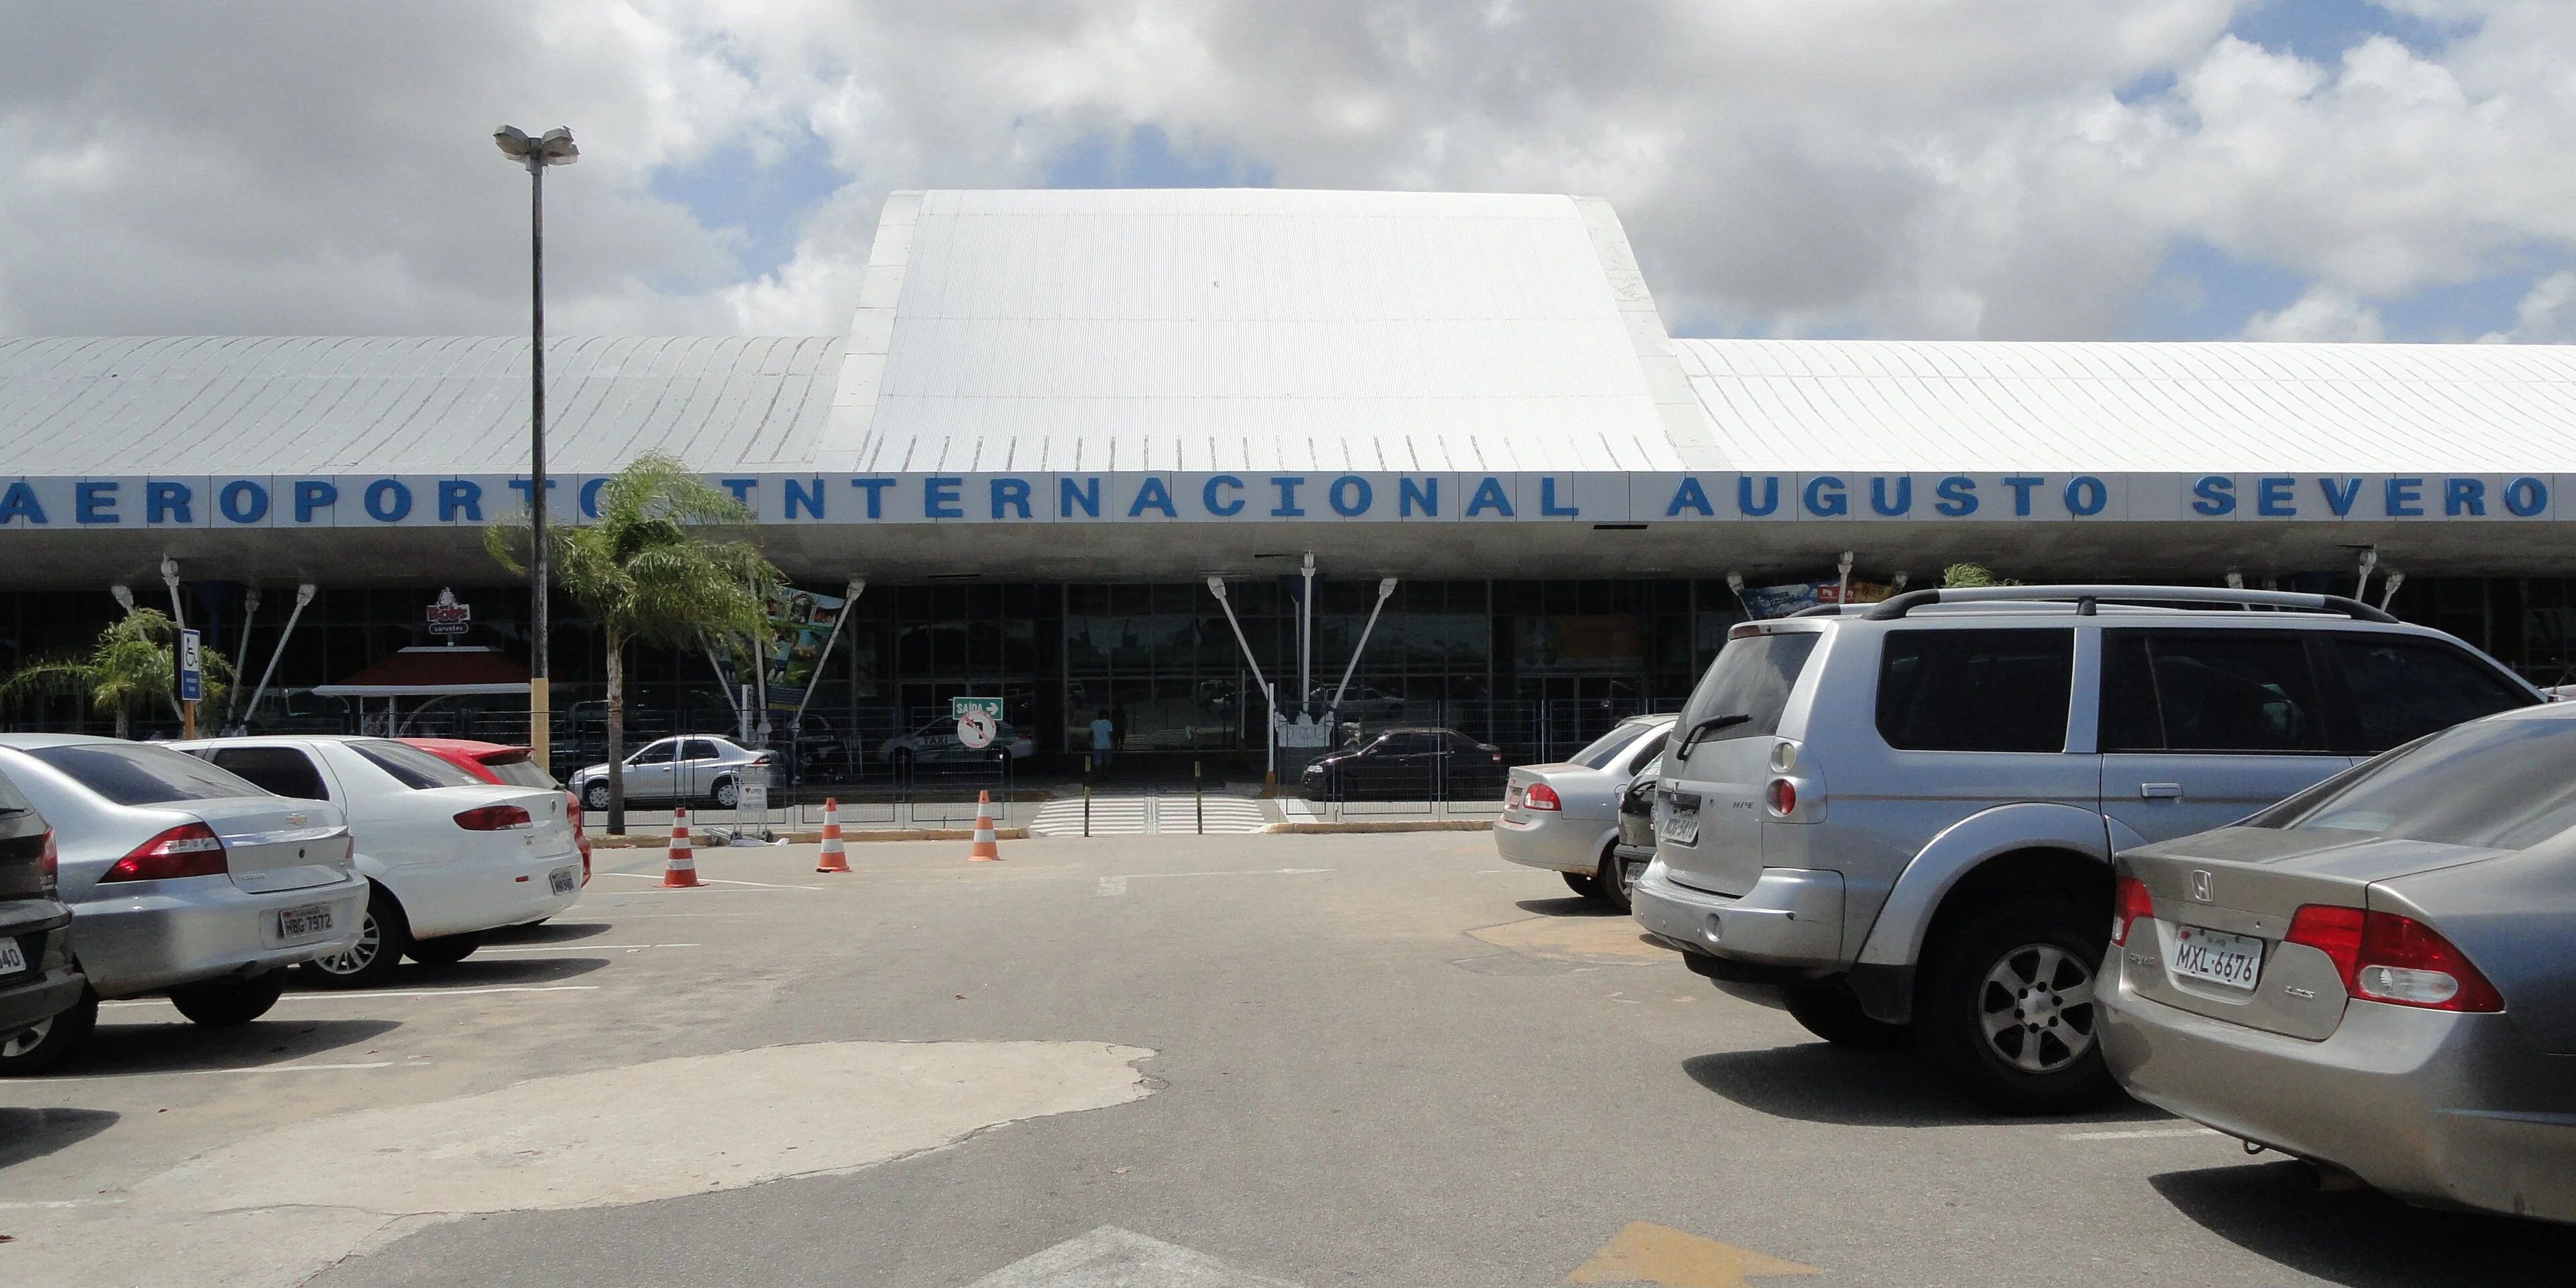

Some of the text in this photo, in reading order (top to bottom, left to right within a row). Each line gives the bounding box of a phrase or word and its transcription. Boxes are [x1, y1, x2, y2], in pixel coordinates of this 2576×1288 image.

[721, 475, 1579, 519] INTERNACIONAL
[1666, 476, 2107, 517] AUGUSTO
[2192, 476, 2548, 517] SEVERO
[957, 702, 983, 714] SAÍDA
